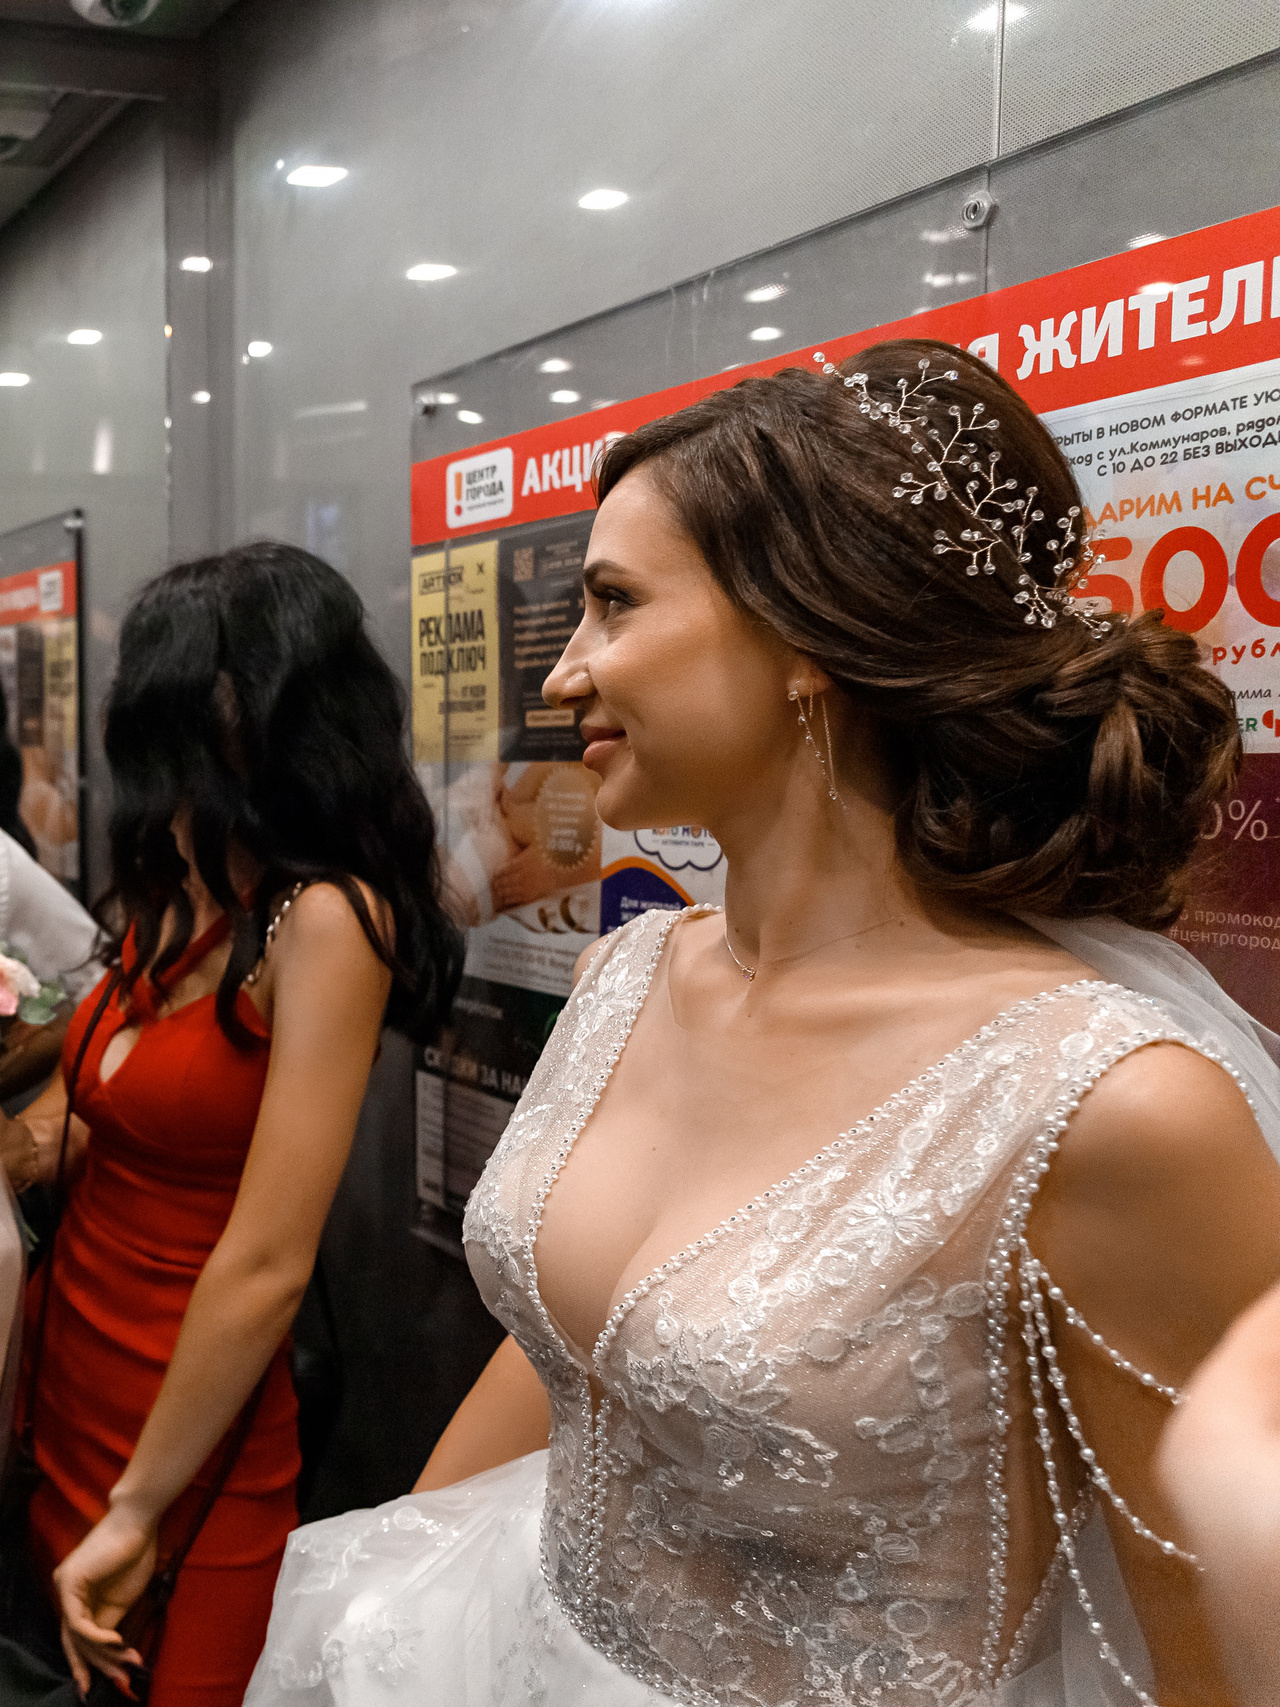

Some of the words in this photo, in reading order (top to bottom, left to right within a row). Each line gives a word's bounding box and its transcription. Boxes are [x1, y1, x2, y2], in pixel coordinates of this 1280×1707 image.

[521, 437, 613, 497] АКЦИ
[1016, 255, 1280, 381] ЖИТЕЛ
[1054, 429, 1092, 446] РЫТЫ
[1096, 427, 1105, 439] В
[1109, 413, 1166, 437] НОВОМ
[1170, 395, 1248, 423] ФОРМАТЕ
[1069, 453, 1093, 467] ход
[1097, 451, 1105, 460] с
[1097, 464, 1108, 477] С
[1112, 461, 1126, 474] 10
[1130, 455, 1156, 473] ДО
[1160, 451, 1179, 466] 22
[1183, 445, 1211, 461] БЕЗ
[1215, 430, 1280, 455] ВЫХОД
[465, 464, 497, 486] ЦЕНТР
[465, 480, 505, 501] ГОРОДА
[1192, 482, 1235, 511] НА
